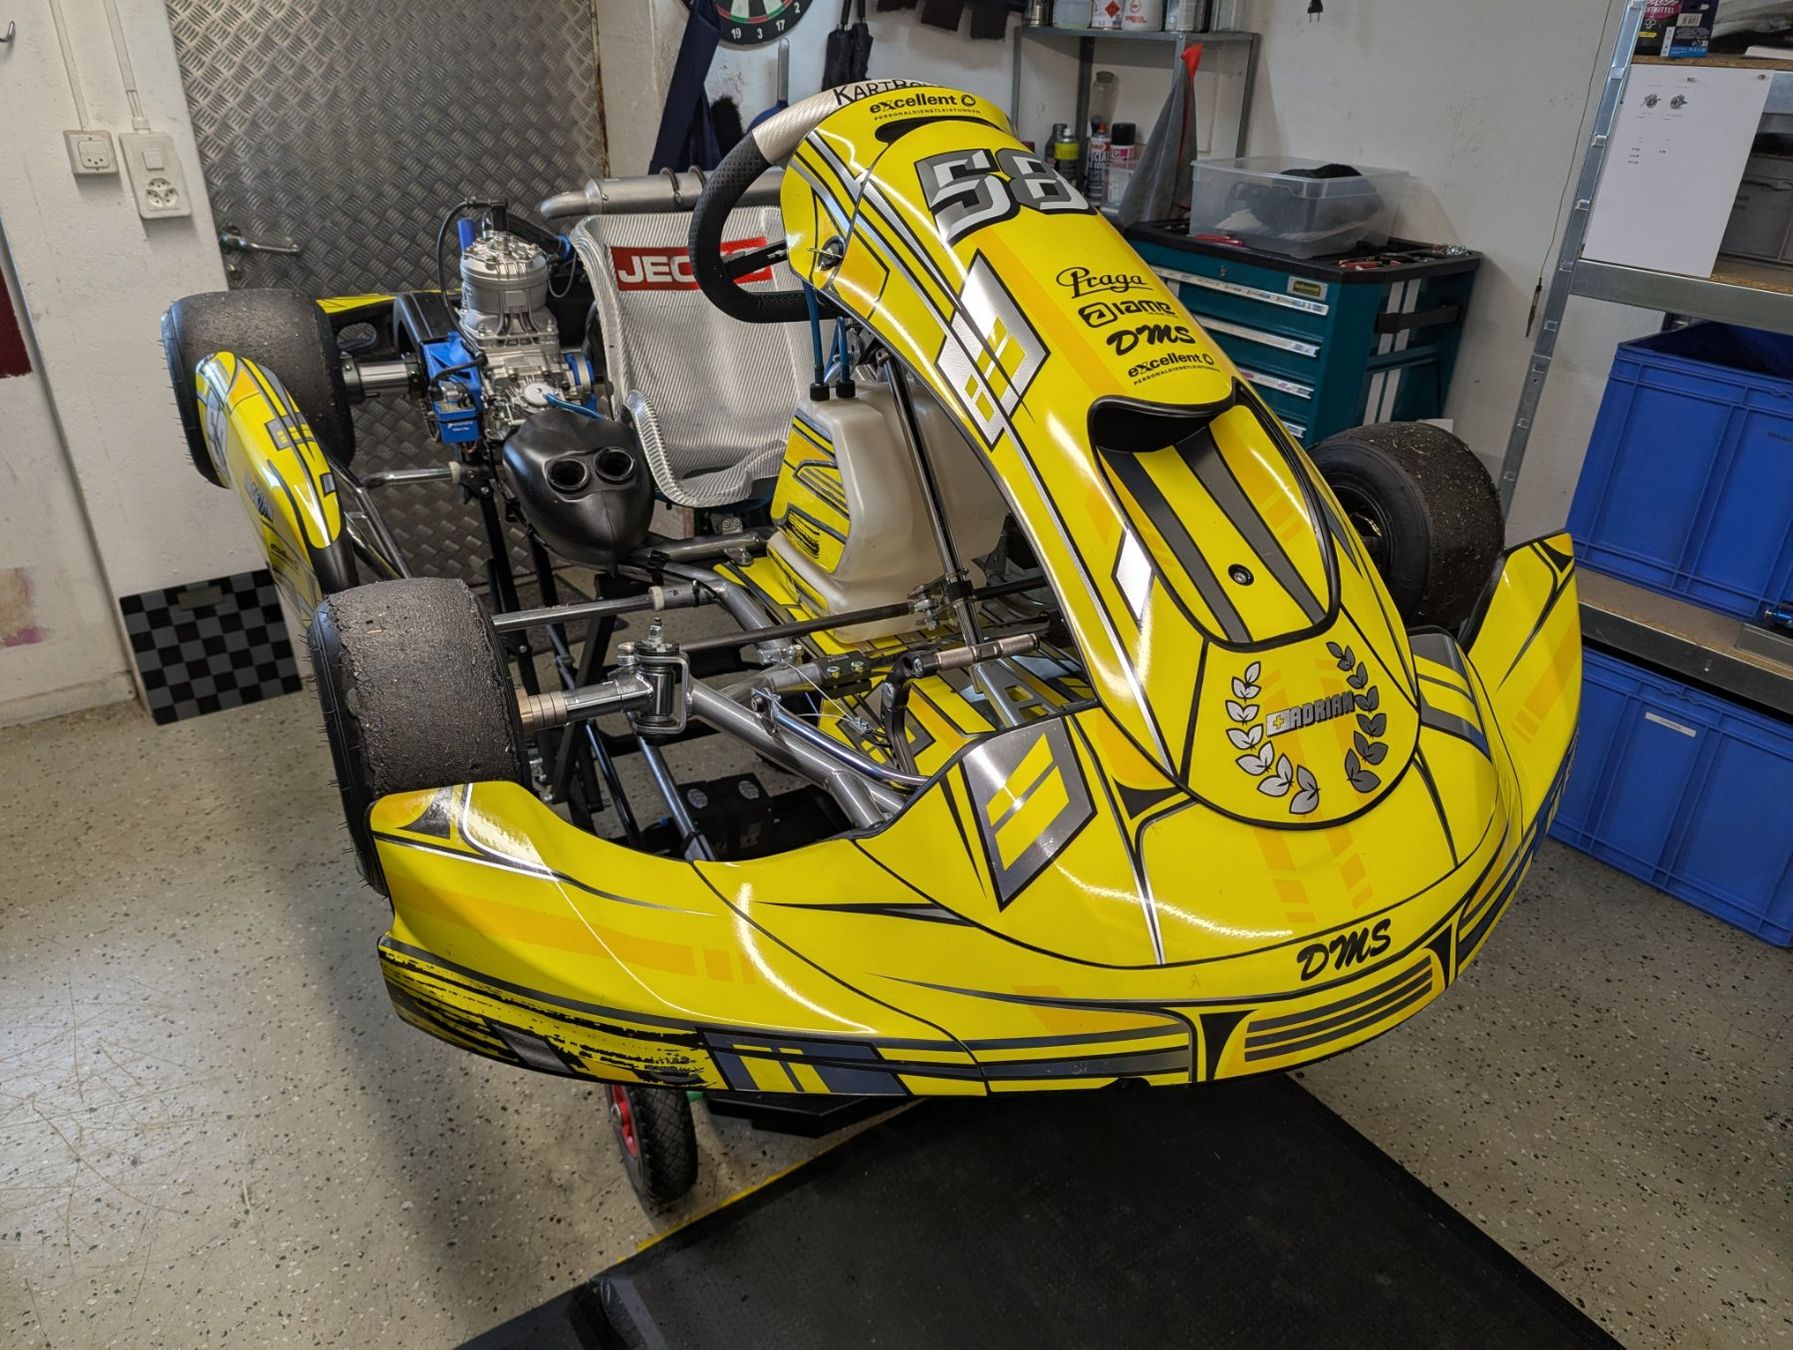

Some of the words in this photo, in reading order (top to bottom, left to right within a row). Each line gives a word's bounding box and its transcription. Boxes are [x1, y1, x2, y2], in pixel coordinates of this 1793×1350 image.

[731, 27, 742, 39] 19
[757, 28, 763, 39] 3
[776, 20, 786, 31] 17
[870, 93, 957, 114] excellent
[913, 147, 1098, 248] 58
[1056, 266, 1153, 299] Praga
[1106, 324, 1196, 356] DMS
[1128, 352, 1202, 378] excellent
[1290, 690, 1355, 729] ADRIAN
[1297, 918, 1391, 981] DMS
